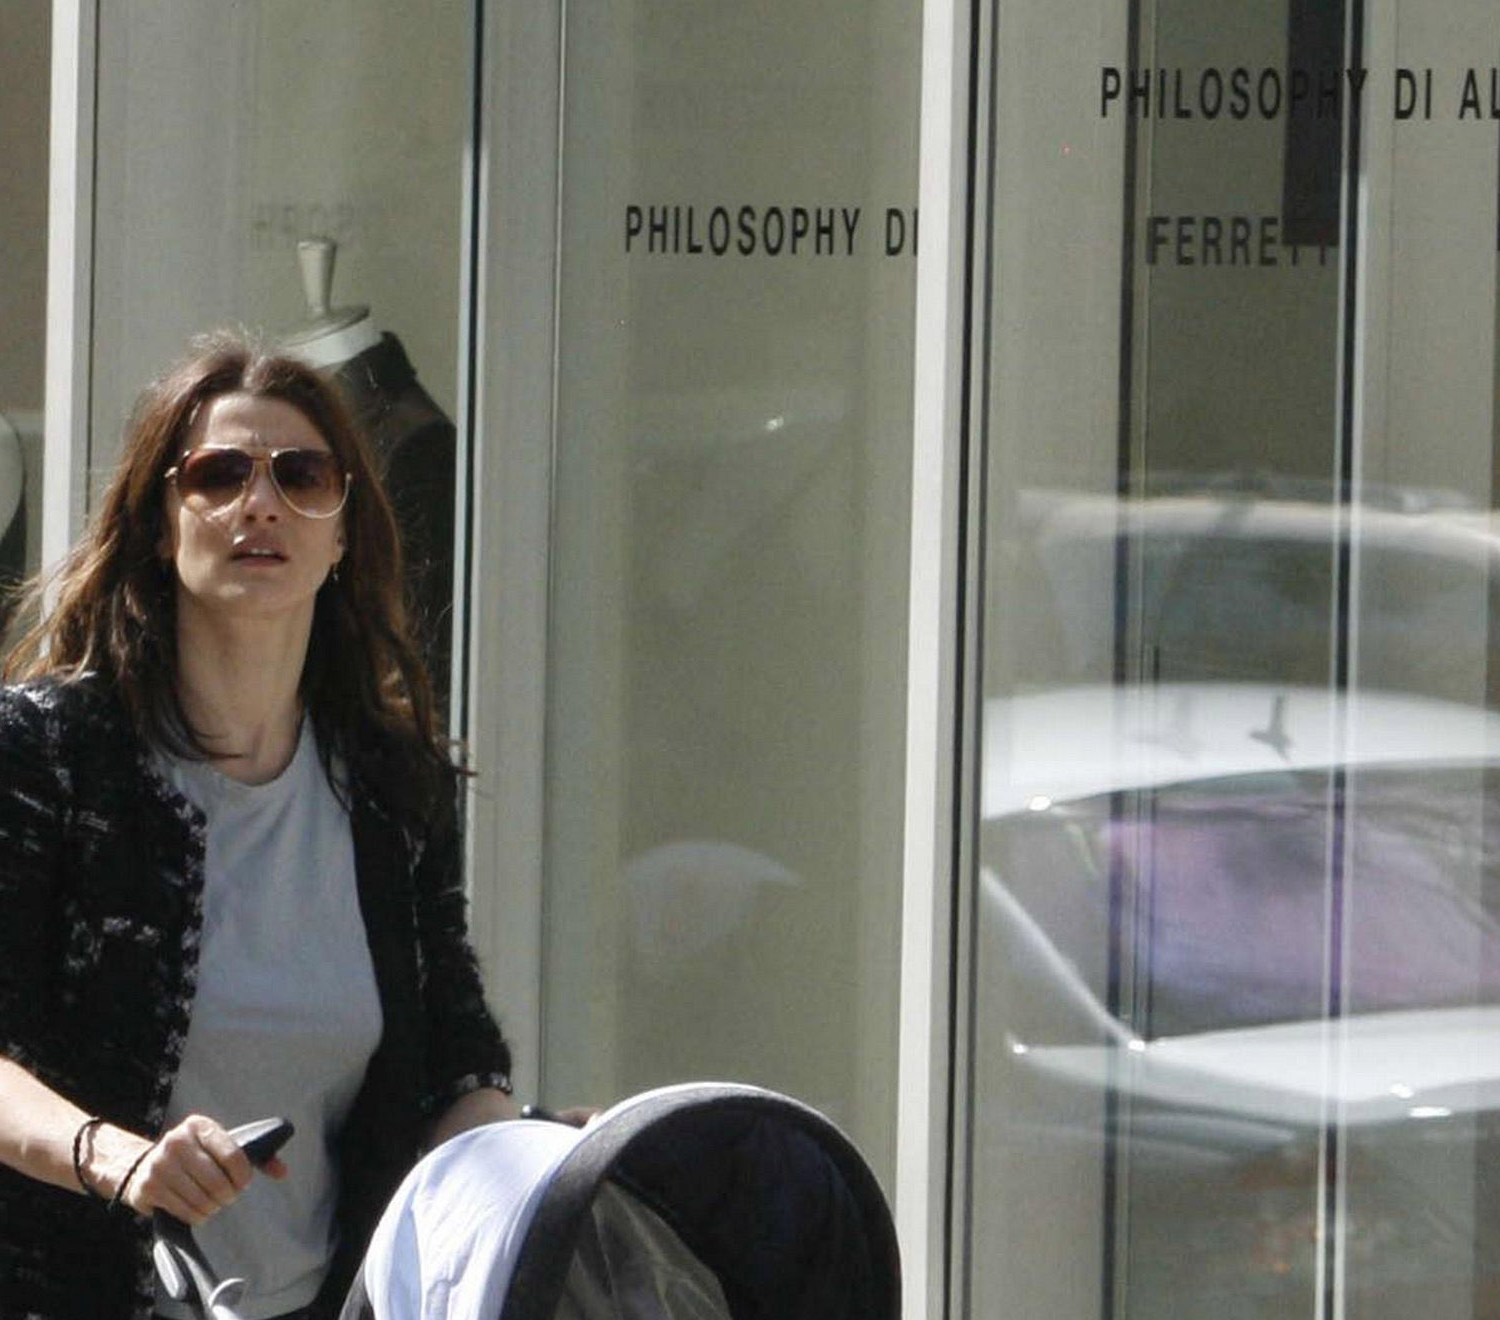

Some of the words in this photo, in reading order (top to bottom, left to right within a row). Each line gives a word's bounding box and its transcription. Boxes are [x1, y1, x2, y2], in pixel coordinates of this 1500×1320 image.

[1101, 66, 1368, 119] PHILOSOPHY
[1394, 68, 1432, 120] DI
[625, 205, 861, 256] PHILOSOPHY
